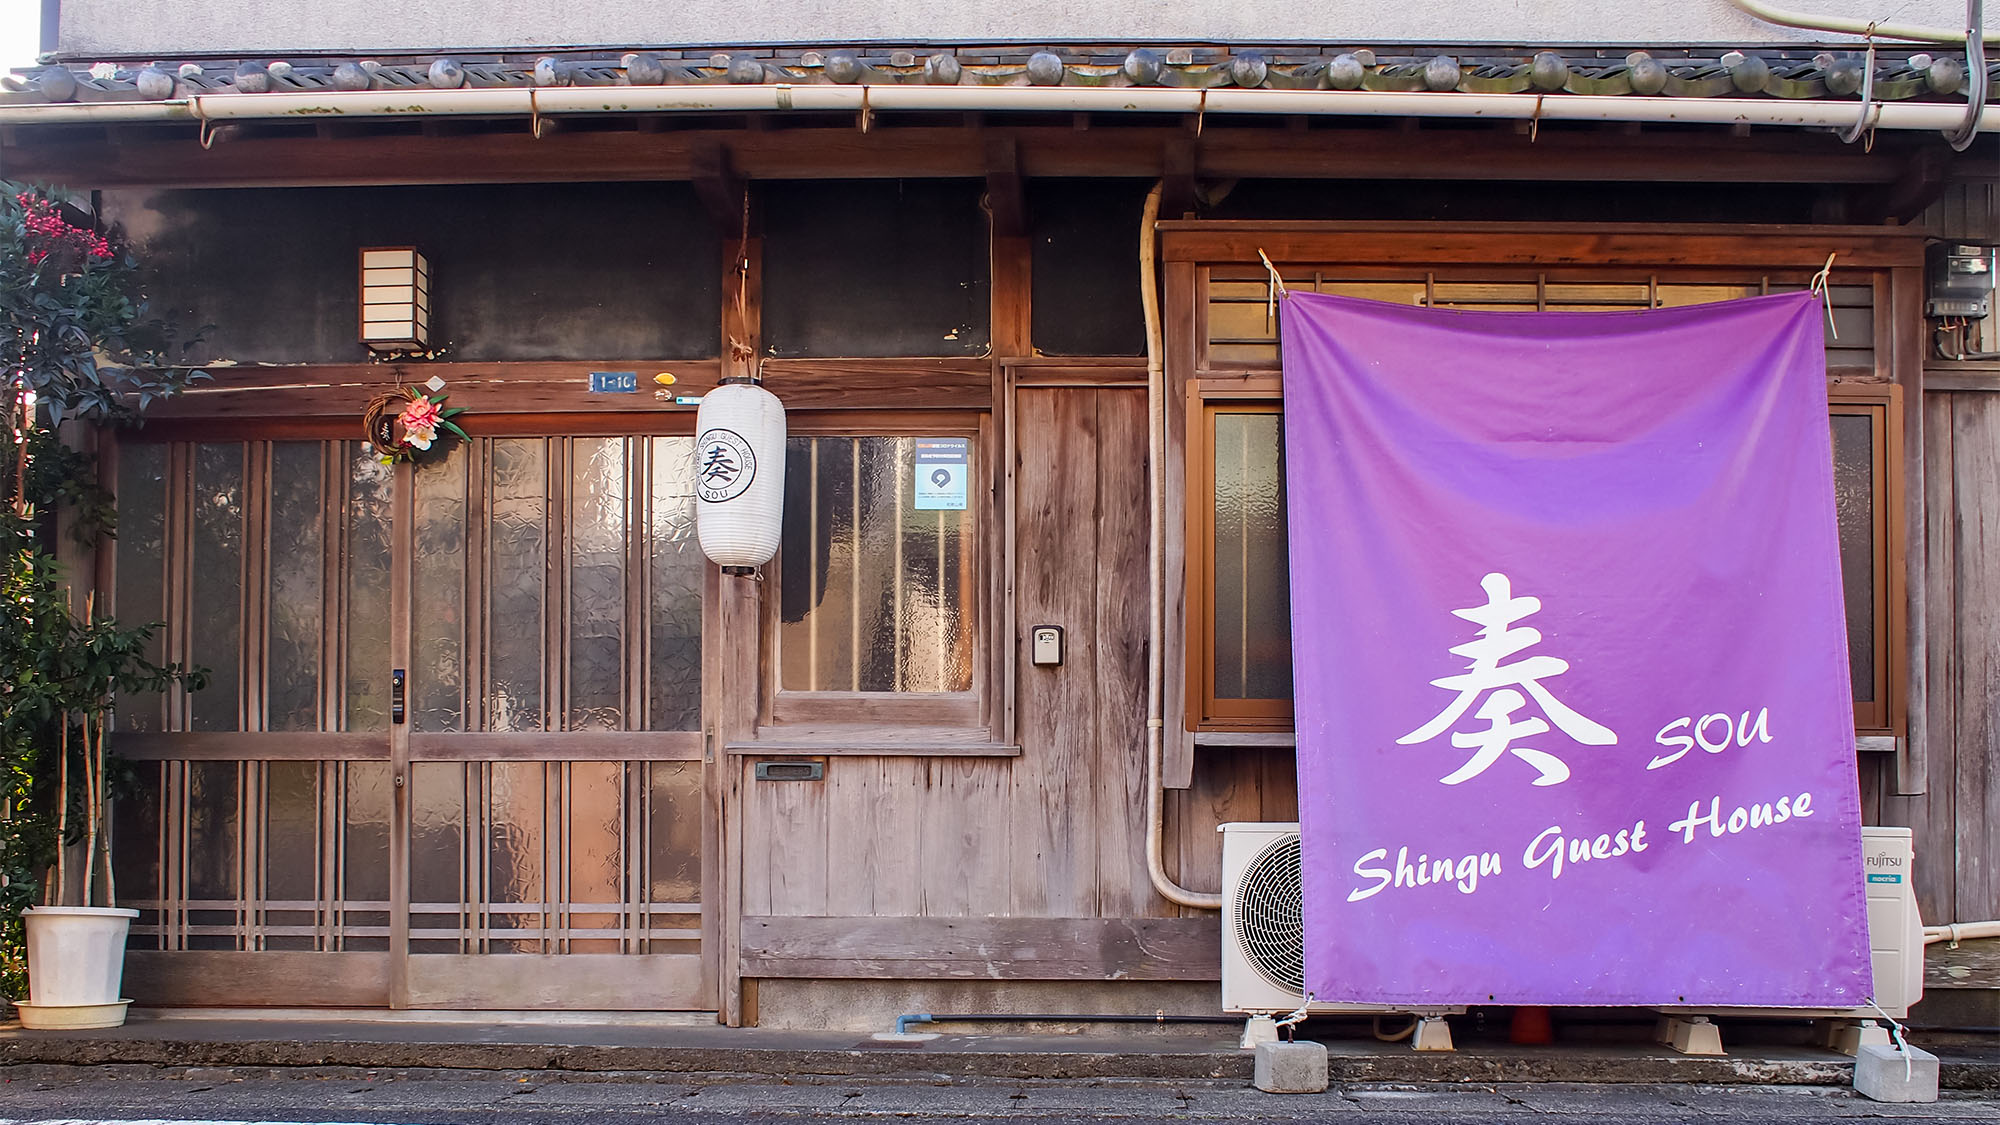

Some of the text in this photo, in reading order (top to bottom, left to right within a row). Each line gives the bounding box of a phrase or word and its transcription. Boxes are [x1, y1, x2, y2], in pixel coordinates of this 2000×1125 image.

[701, 445, 740, 483] 奏
[720, 432, 742, 447] GUEST
[741, 448, 753, 470] HOUSE
[704, 489, 728, 500] SOU
[1396, 572, 1618, 787] 奏
[1647, 707, 1774, 770] SOU
[1346, 792, 1815, 903] Shingu Guest House
[1866, 851, 1902, 868] FUJITSU
